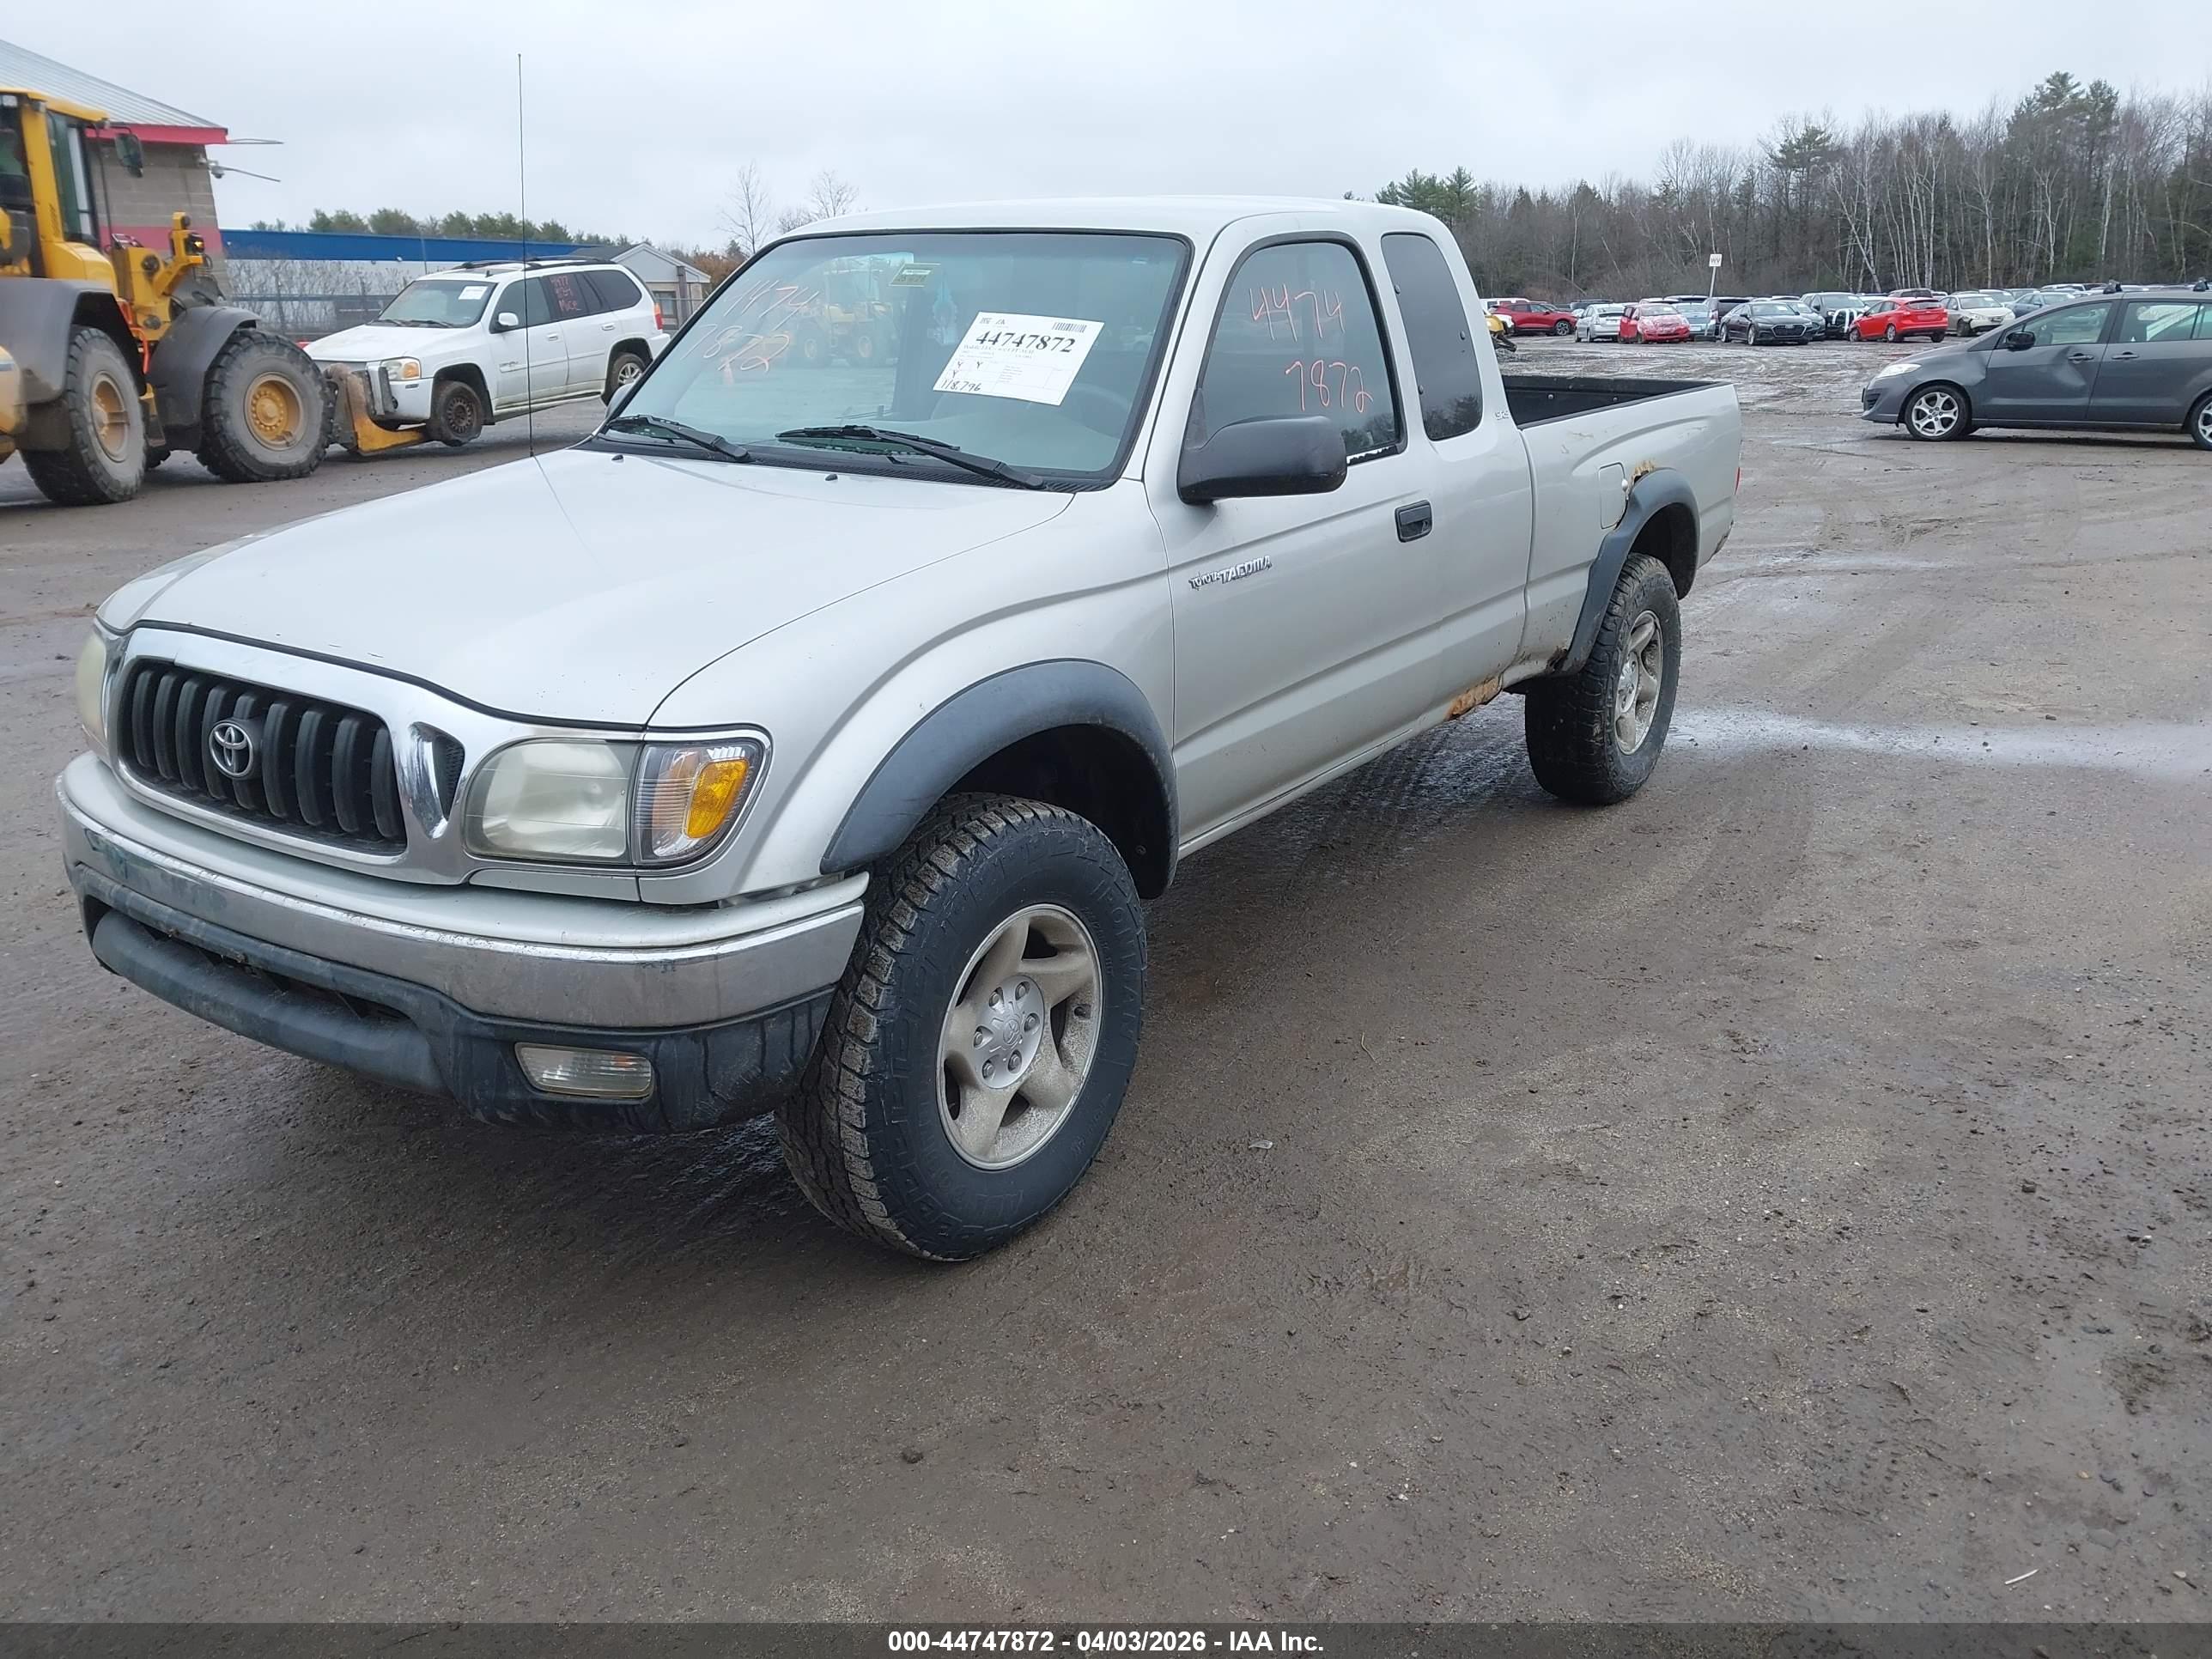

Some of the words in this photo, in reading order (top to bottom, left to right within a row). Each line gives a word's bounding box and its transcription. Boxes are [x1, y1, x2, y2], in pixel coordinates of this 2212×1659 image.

[1249, 284, 1346, 342] 4474
[680, 324, 790, 373] 7872
[976, 331, 1076, 353] 44747872
[1285, 359, 1374, 413] 7872
[1219, 555, 1272, 584] TACOMA
